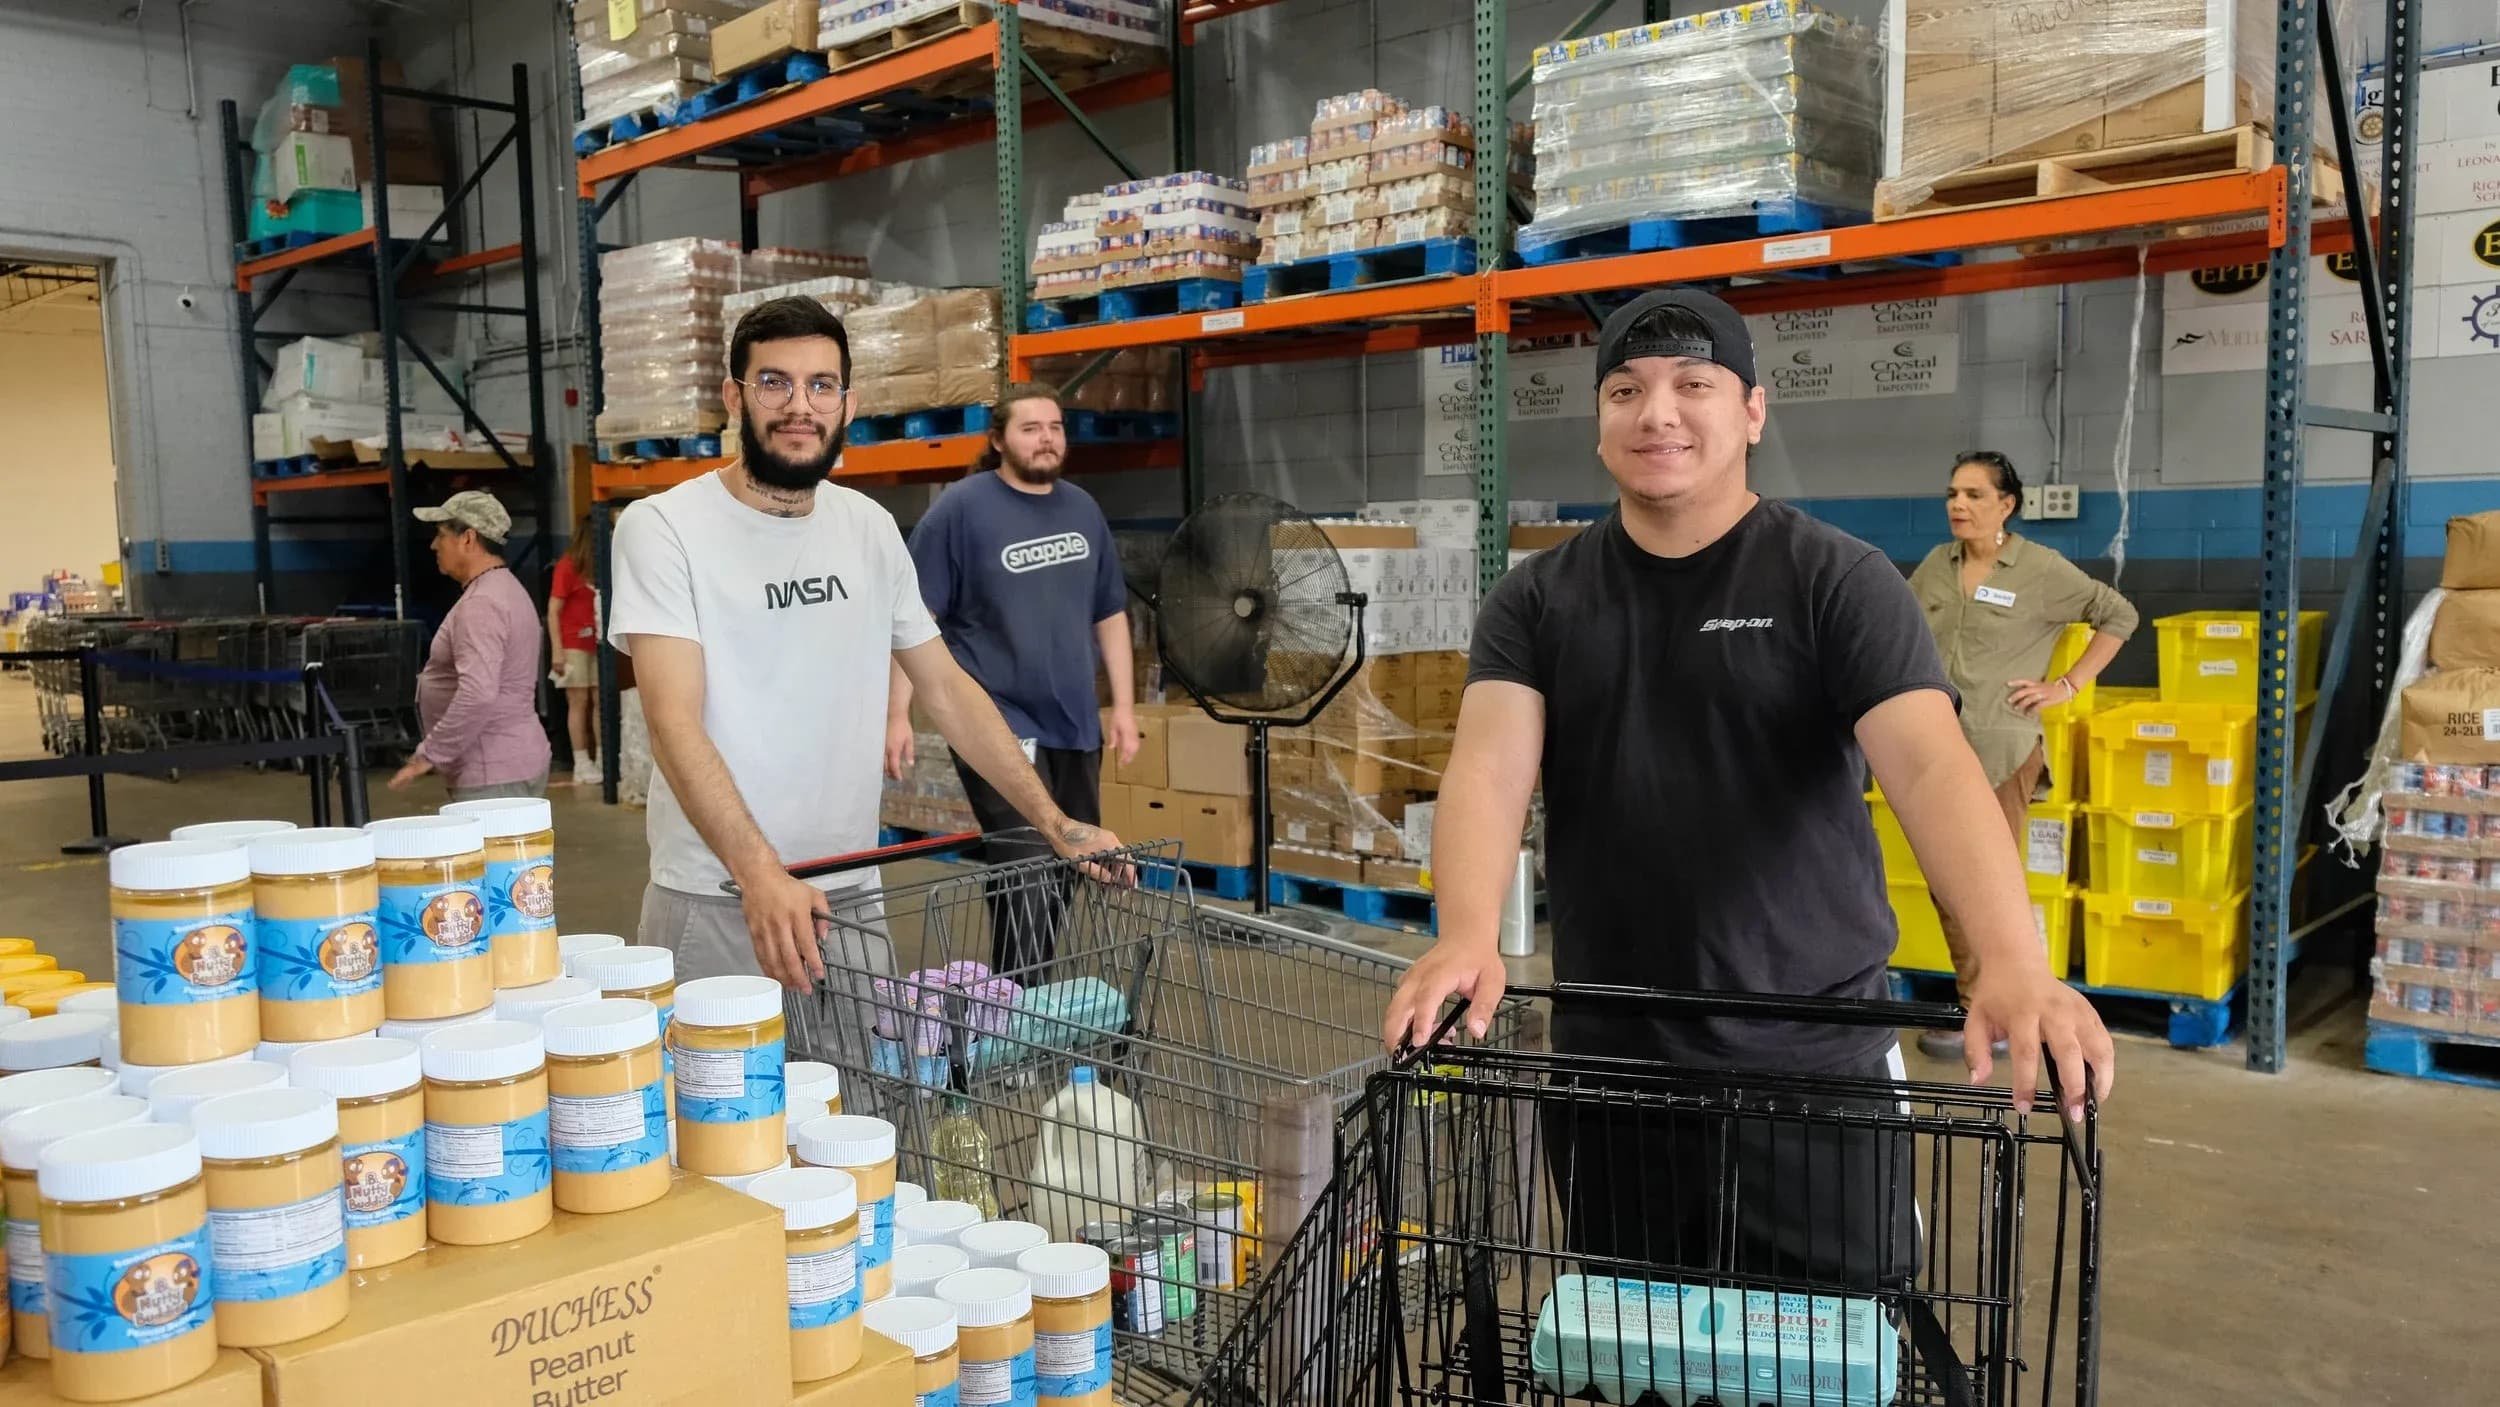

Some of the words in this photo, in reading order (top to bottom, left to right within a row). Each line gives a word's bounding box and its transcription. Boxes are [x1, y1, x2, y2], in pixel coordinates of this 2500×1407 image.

[1875, 310, 1933, 323] Clean
[1776, 320, 1829, 333] Clean
[1771, 363, 1833, 379] Crystal
[1871, 355, 1937, 374] Crystal
[1776, 376, 1829, 389] Clean
[1874, 371, 1933, 384] Clean
[1514, 384, 1564, 398] Crystal
[1516, 397, 1561, 408] Clean
[1009, 535, 1086, 568] snapple
[765, 574, 849, 610] NASA
[2448, 712, 2480, 725] RICE
[530, 1331, 636, 1386] Peanut
